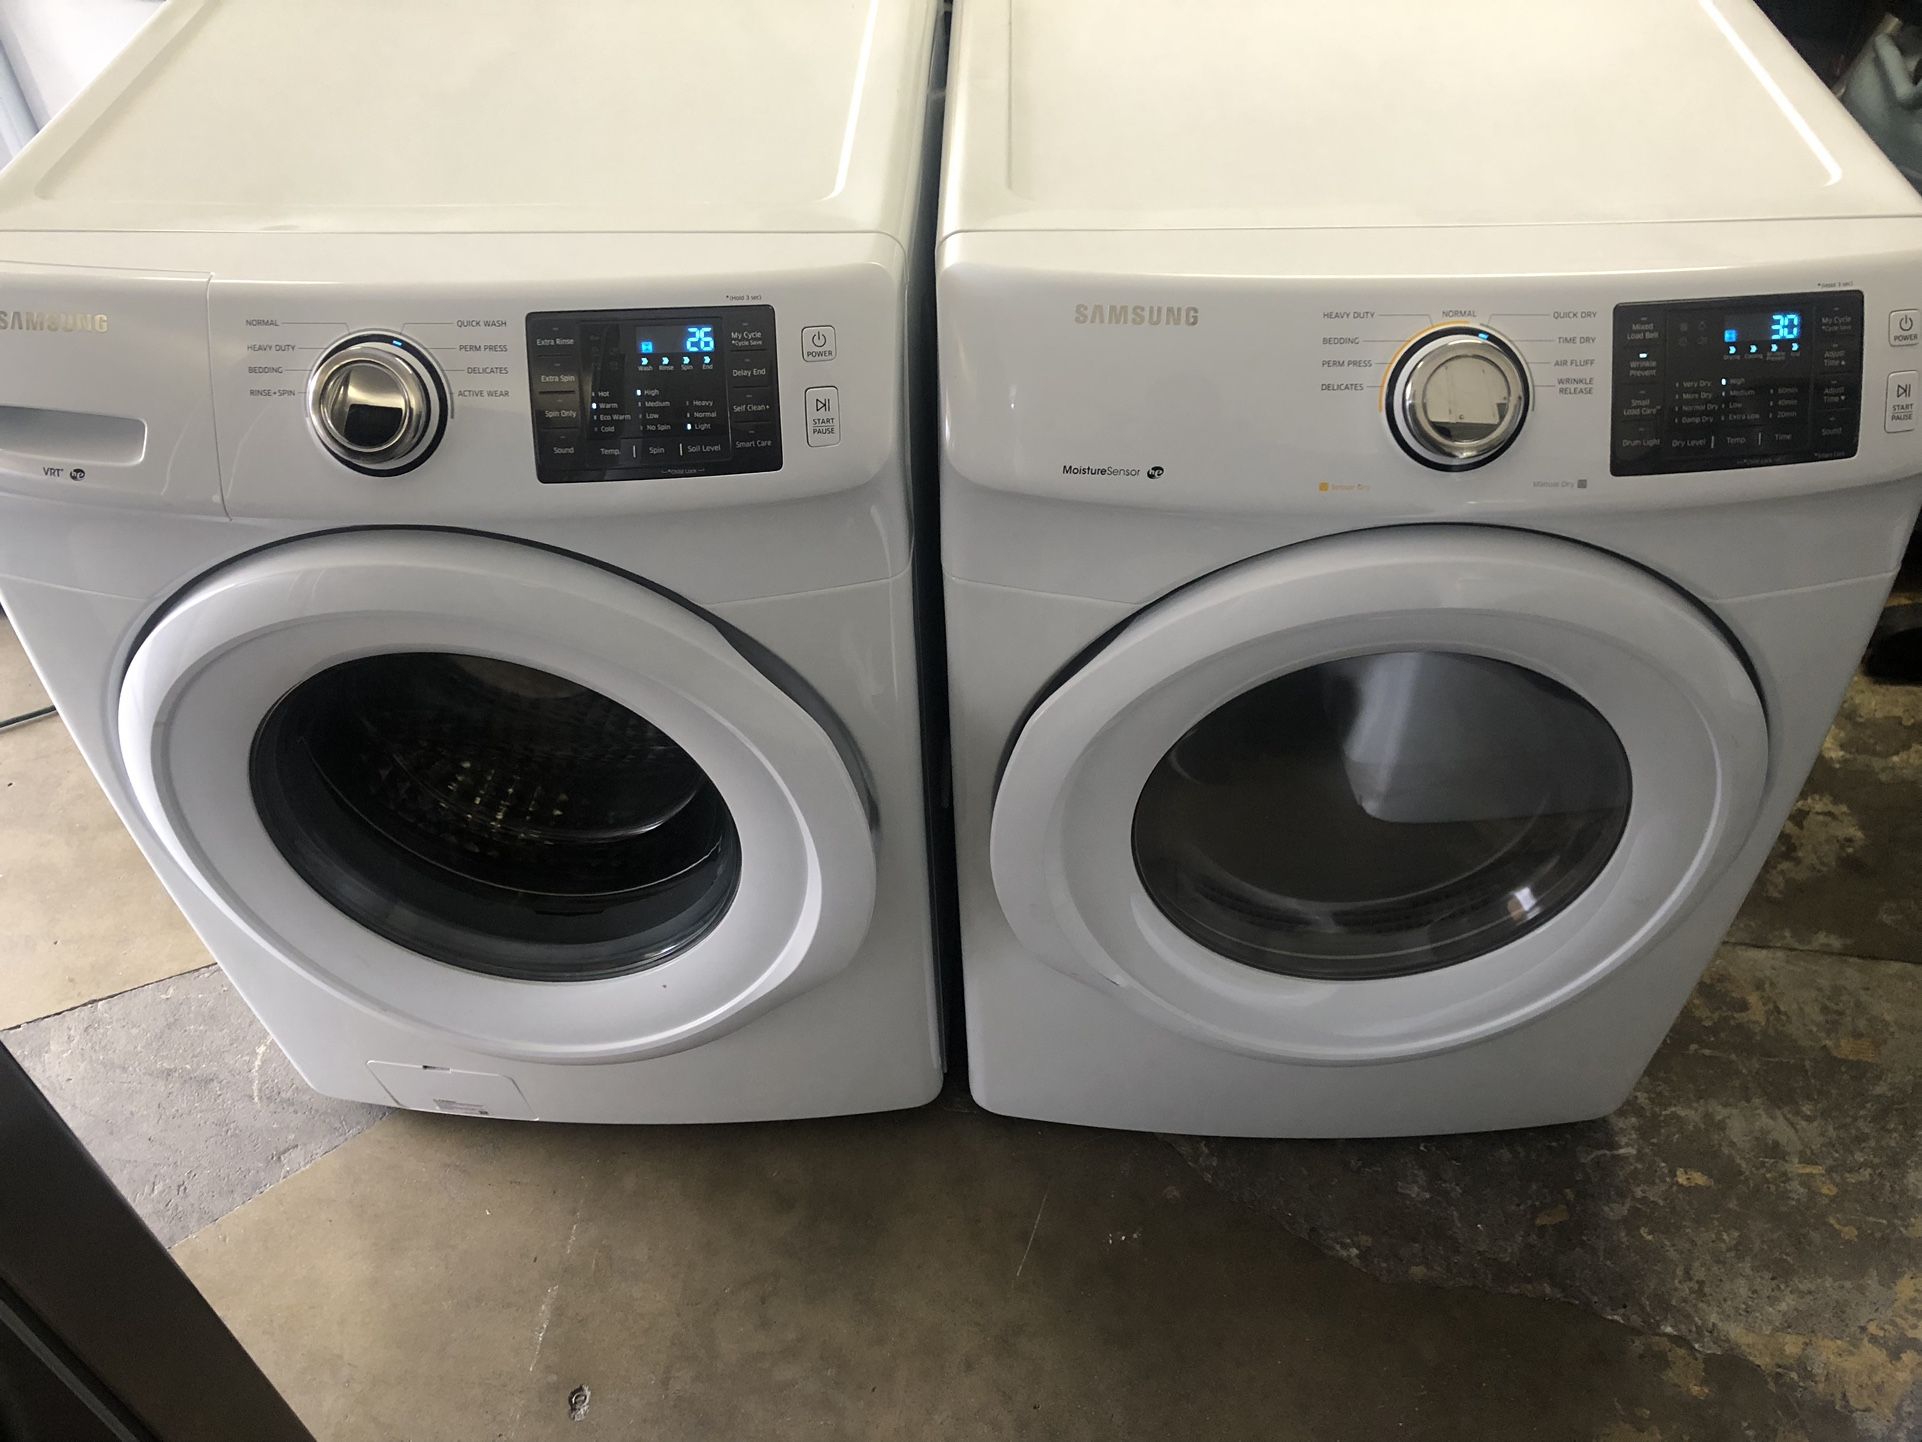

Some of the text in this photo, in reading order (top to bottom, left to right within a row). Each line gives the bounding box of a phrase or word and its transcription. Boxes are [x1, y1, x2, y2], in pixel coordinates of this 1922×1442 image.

[1074, 303, 1199, 326] SAMSUNG
[1323, 311, 1375, 319] HEAVY DUTY
[1442, 310, 1477, 318] NORMAL
[1552, 311, 1597, 319] QUICK DRY
[0, 311, 108, 332] SAMSUNG
[246, 319, 280, 327] NORMAL
[456, 319, 507, 328] QUICK WASH
[1834, 316, 1851, 324] Cycle
[1771, 314, 1799, 340] 30
[686, 327, 714, 352] 26
[731, 331, 762, 340] My Cycle
[1894, 333, 1918, 342] POWER
[536, 338, 555, 346] Extra
[1322, 337, 1360, 345] BEDDING
[1558, 336, 1597, 344] TIME DRY
[247, 344, 272, 352] HEAVY
[459, 344, 508, 352] PERM PRESS
[807, 350, 833, 358] POWER
[1347, 359, 1373, 367] PRESS
[1553, 359, 1596, 367] AIR FLUFF
[248, 366, 283, 374] BEDDING
[466, 366, 509, 375] DELICATES
[732, 368, 766, 377] Delay End
[1557, 377, 1594, 385] WRINKLE
[1321, 383, 1364, 391] DELICATES
[1558, 387, 1594, 395] RELEASE
[486, 389, 510, 397] WEAR
[1707, 403, 1718, 411] Dry
[1892, 403, 1914, 411] START
[545, 410, 577, 418] Spin Only
[1891, 413, 1913, 421] PAUSE
[812, 417, 835, 425] START
[695, 423, 711, 431] Light
[812, 427, 835, 435] PAUSE
[736, 440, 755, 448] Smart
[1687, 438, 1706, 446] Level
[553, 446, 575, 454] Sound
[688, 444, 721, 453] Soil Level
